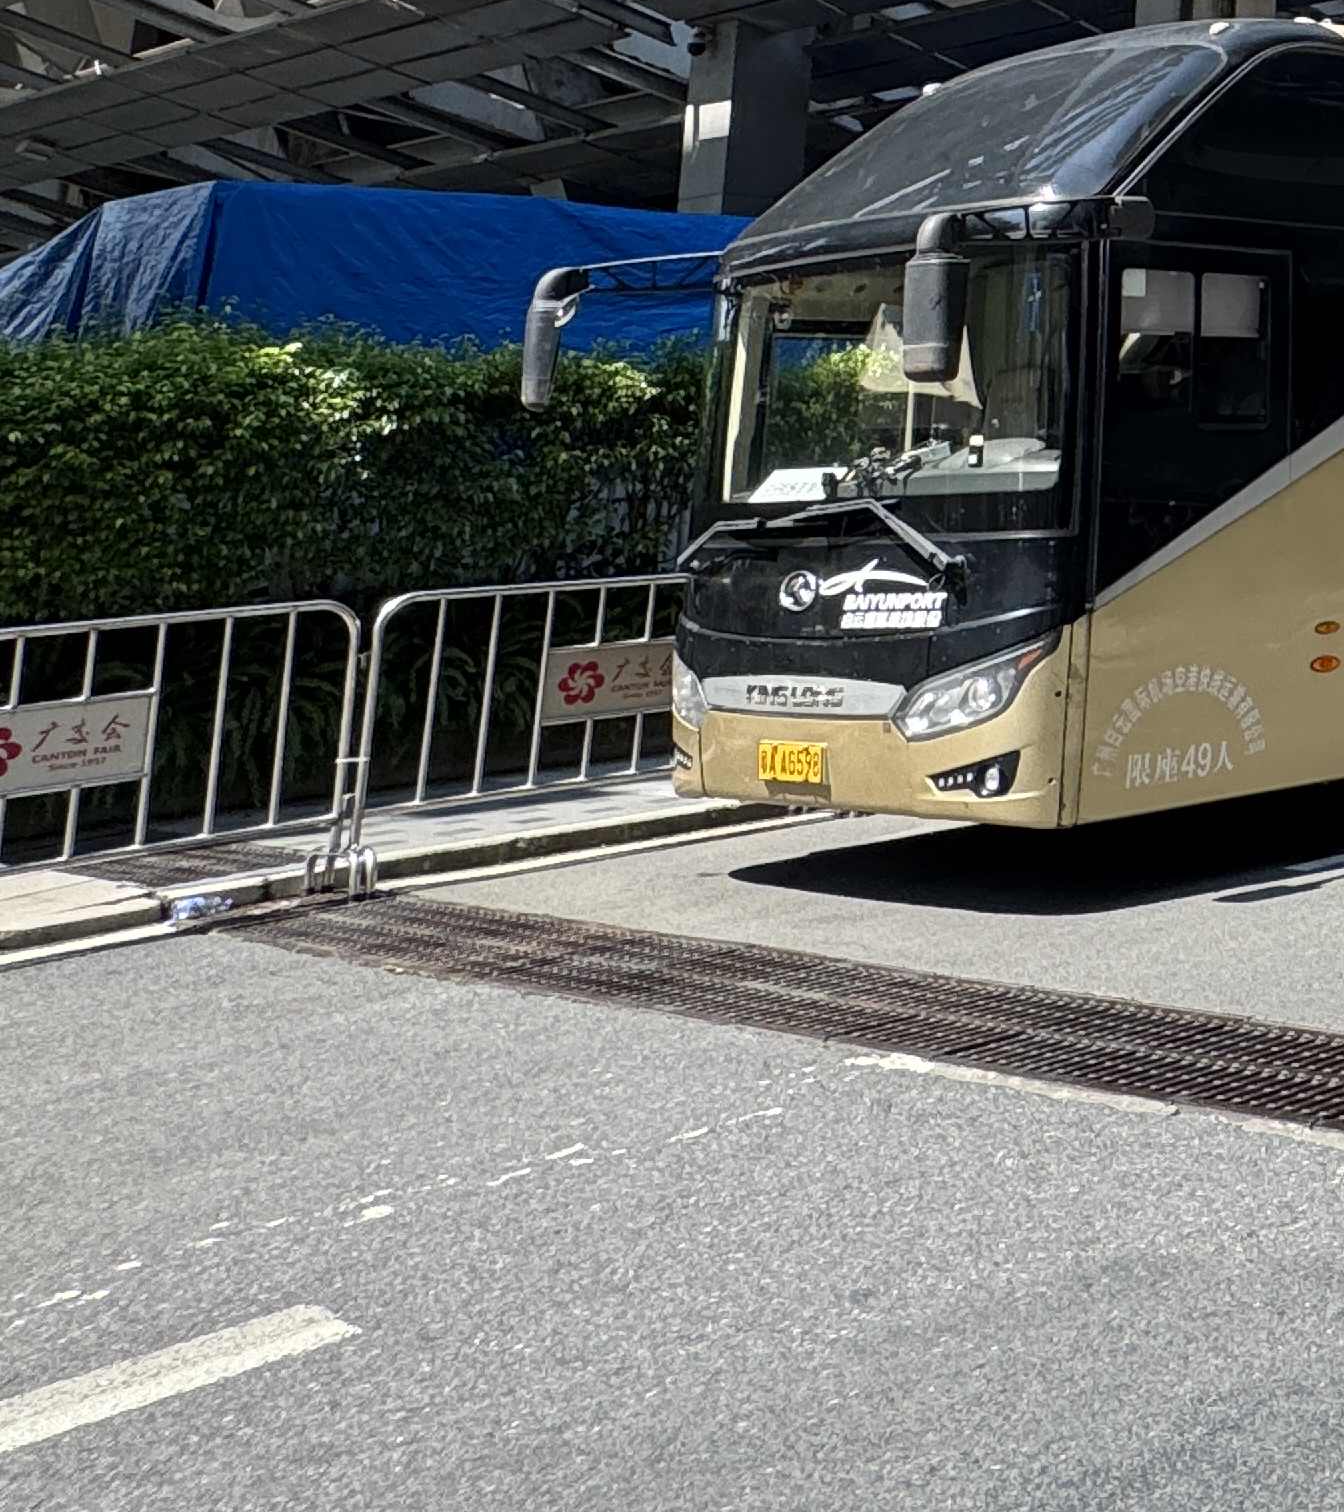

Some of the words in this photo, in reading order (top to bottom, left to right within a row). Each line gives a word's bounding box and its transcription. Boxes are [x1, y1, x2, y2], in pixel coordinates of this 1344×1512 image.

[32, 749, 88, 764] CANTON
[93, 744, 122, 755] FAIR
[1125, 740, 1234, 789] 限座49人
